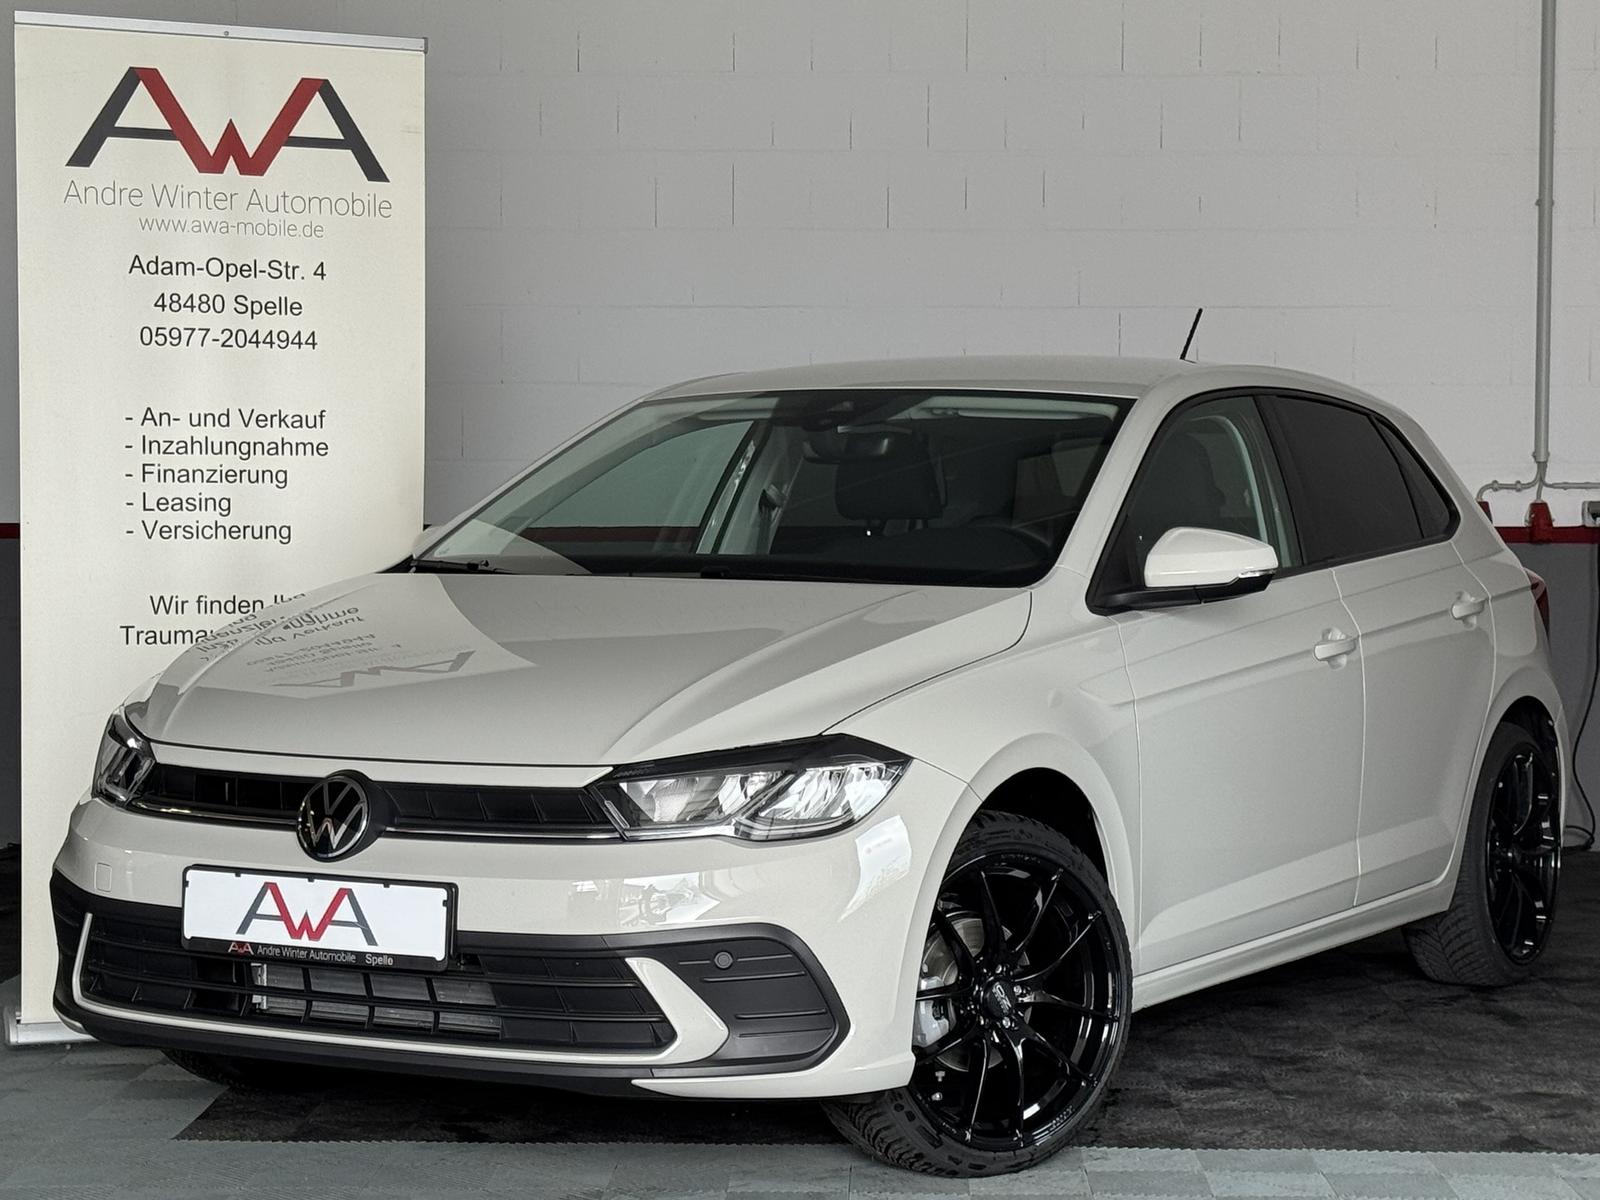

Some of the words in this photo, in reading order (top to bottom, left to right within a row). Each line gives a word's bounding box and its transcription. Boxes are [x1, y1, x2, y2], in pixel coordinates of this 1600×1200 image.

[64, 180, 143, 207] Andre
[151, 183, 238, 211] Winter
[246, 188, 392, 219] Automobile
[139, 215, 324, 239] www.awa-mobile.de
[128, 254, 305, 282] Adam-Opel-Str.
[313, 261, 326, 281] 4
[153, 292, 225, 314] 48480
[233, 295, 303, 318] Spelle
[139, 326, 318, 350] 05977-2044944
[141, 407, 181, 428] An-
[188, 408, 231, 428] und
[238, 408, 326, 429] Verkauf
[141, 436, 329, 461] Inzahlungnahme
[141, 464, 288, 489] Finanzierung
[142, 493, 232, 517] Leasing
[141, 520, 292, 545] Versicherung
[150, 595, 189, 615] Wir
[196, 595, 264, 615] finden
[120, 626, 213, 645] Trauma
[256, 945, 281, 957] Andre
[282, 948, 307, 959] Winter
[309, 950, 356, 963] Automobile
